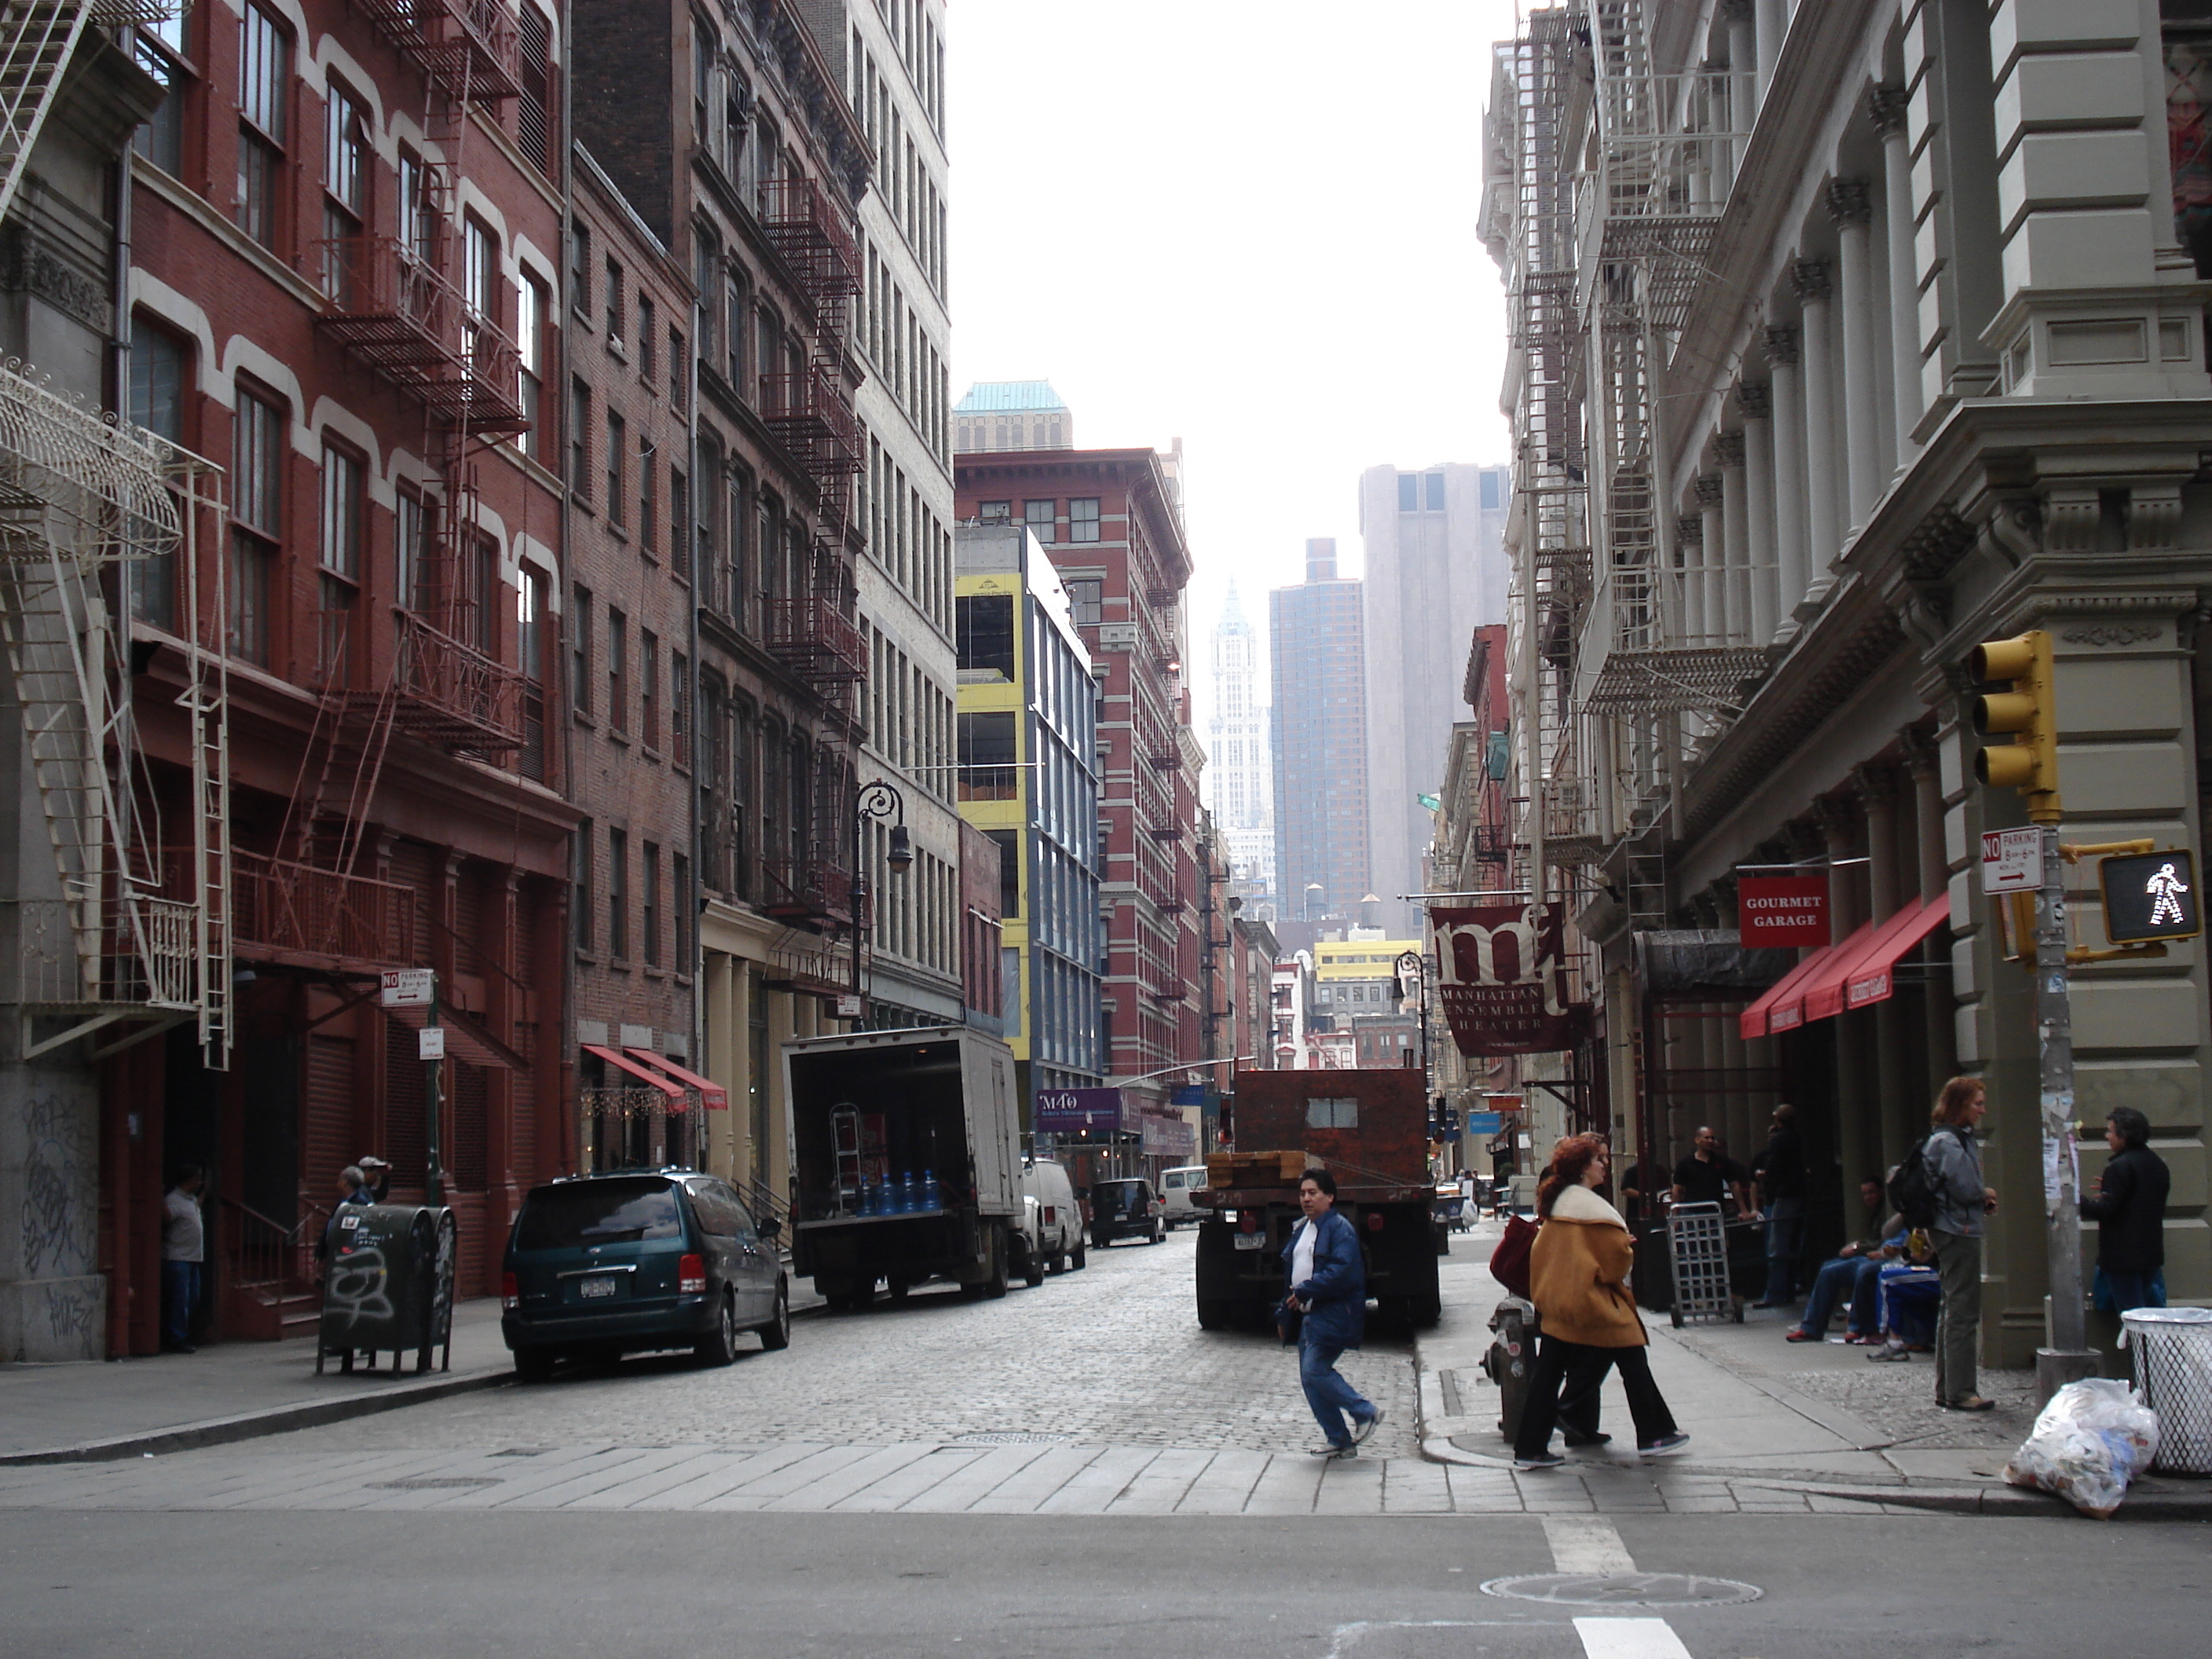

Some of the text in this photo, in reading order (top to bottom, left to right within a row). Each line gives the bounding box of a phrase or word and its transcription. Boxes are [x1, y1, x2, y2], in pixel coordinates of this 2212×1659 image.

[1983, 832, 2038, 859] NO PARKING
[1746, 896, 1822, 909] GOURMET
[1754, 915, 1817, 927] GARAGE
[383, 974, 397, 987] NO
[1442, 987, 1540, 1002] MANHATTAN
[1445, 1004, 1540, 1017] ENSEMBLE
[1459, 1019, 1542, 1031] HEATER
